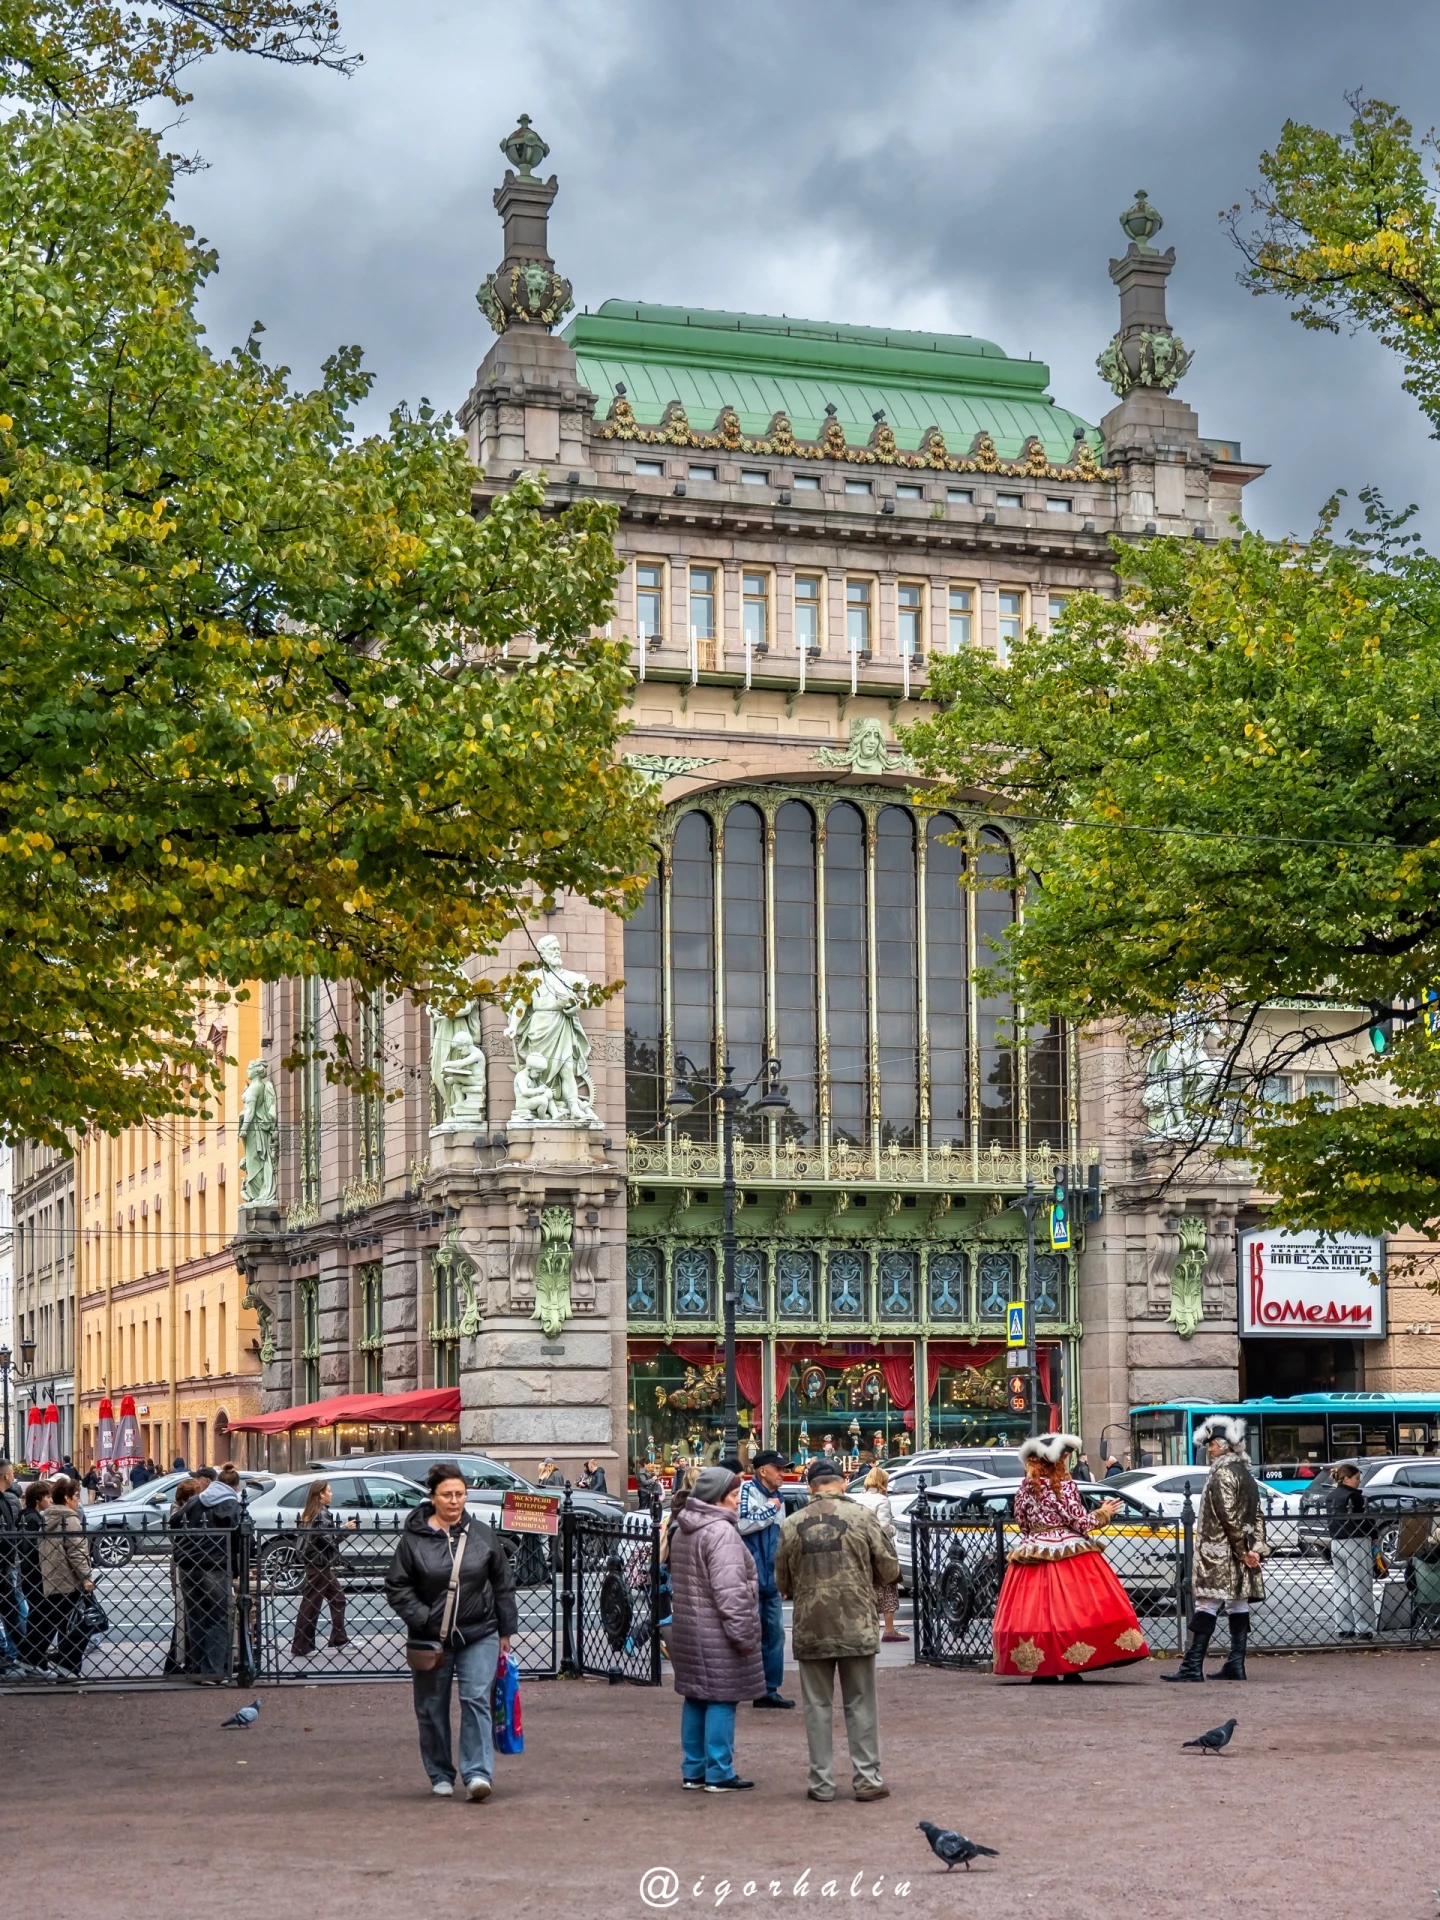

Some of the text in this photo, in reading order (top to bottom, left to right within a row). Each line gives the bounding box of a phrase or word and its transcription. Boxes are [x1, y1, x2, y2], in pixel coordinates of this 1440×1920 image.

[1271, 1253, 1372, 1265] ТЕАТР
[1013, 1398, 1025, 1409] 59
[1265, 1470, 1283, 1479] 6998
[512, 1494, 552, 1504] ЭКСКУРСИИ
[514, 1502, 548, 1510] ПЕТЕРГОФ
[514, 1515, 546, 1523] ОБЗОРНАЯ
[511, 1521, 549, 1530] КРОНШТАДТ
